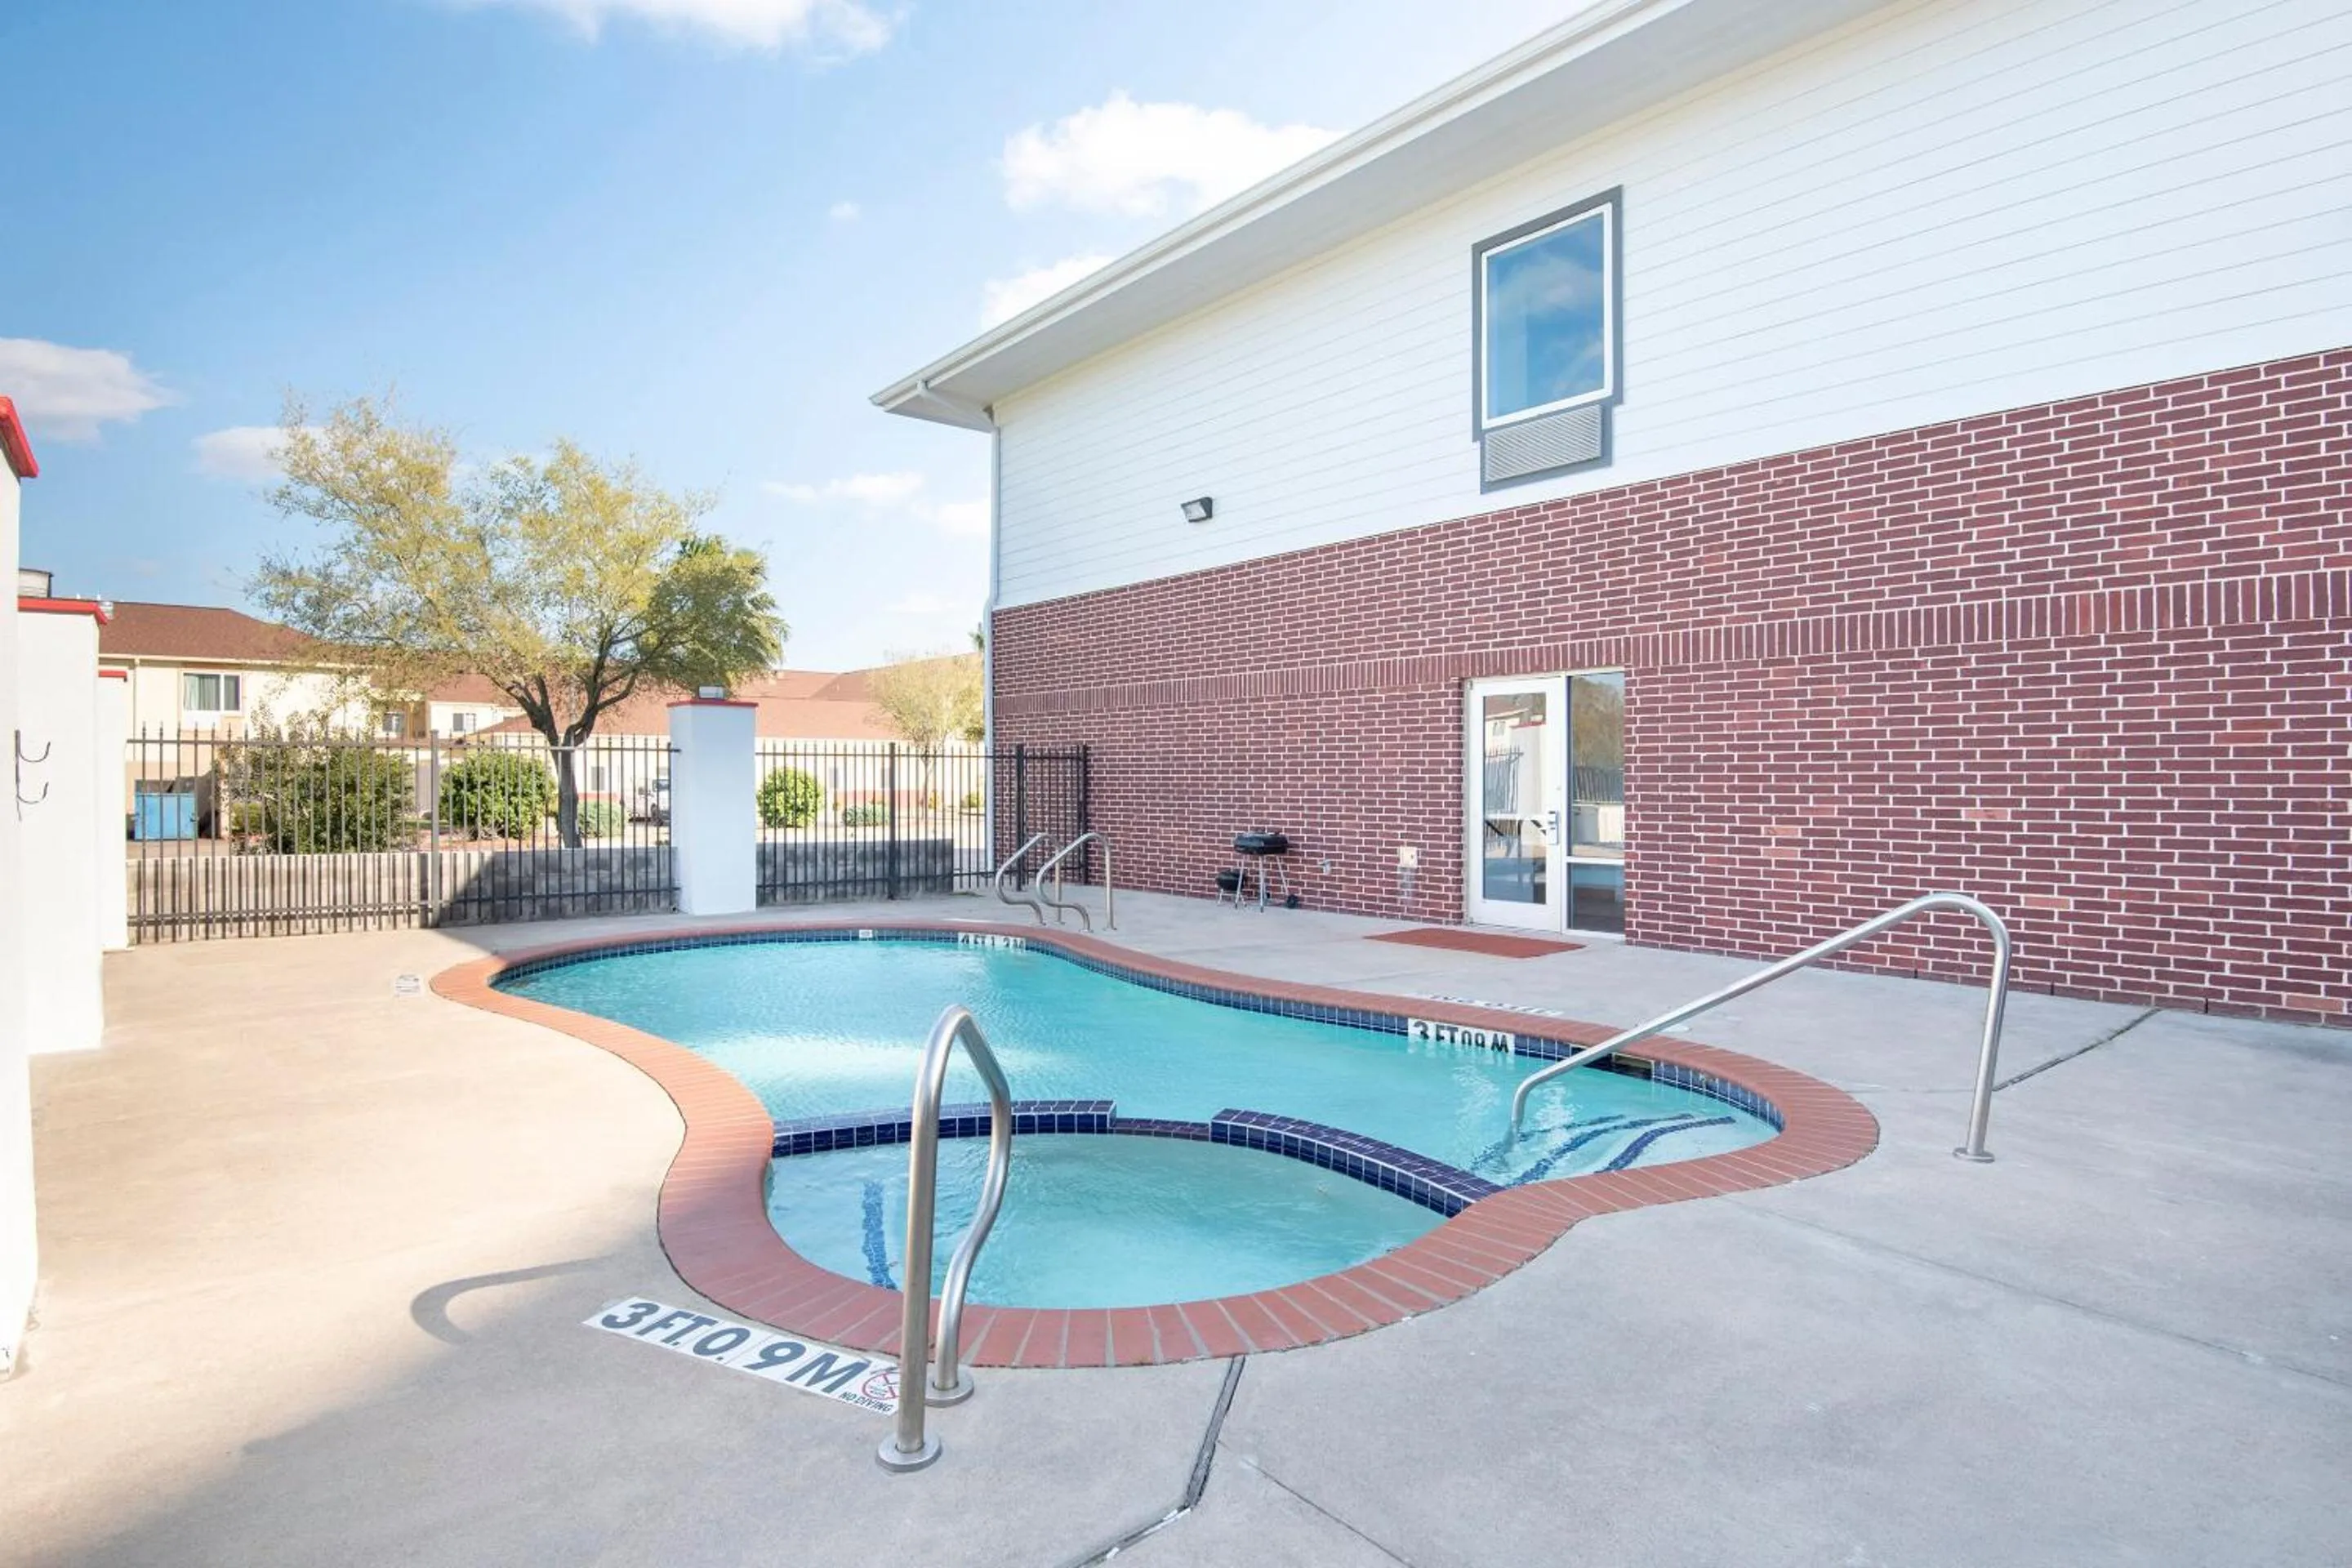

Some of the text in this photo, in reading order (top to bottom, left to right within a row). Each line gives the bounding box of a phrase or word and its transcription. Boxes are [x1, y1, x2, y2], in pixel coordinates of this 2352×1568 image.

[1414, 1021, 1429, 1040] 3
[1436, 1024, 1459, 1045] FT
[1490, 1033, 1509, 1054] M
[601, 1303, 661, 1329] 3
[784, 1352, 871, 1393] M
[839, 1391, 895, 1415] NO DIVING
